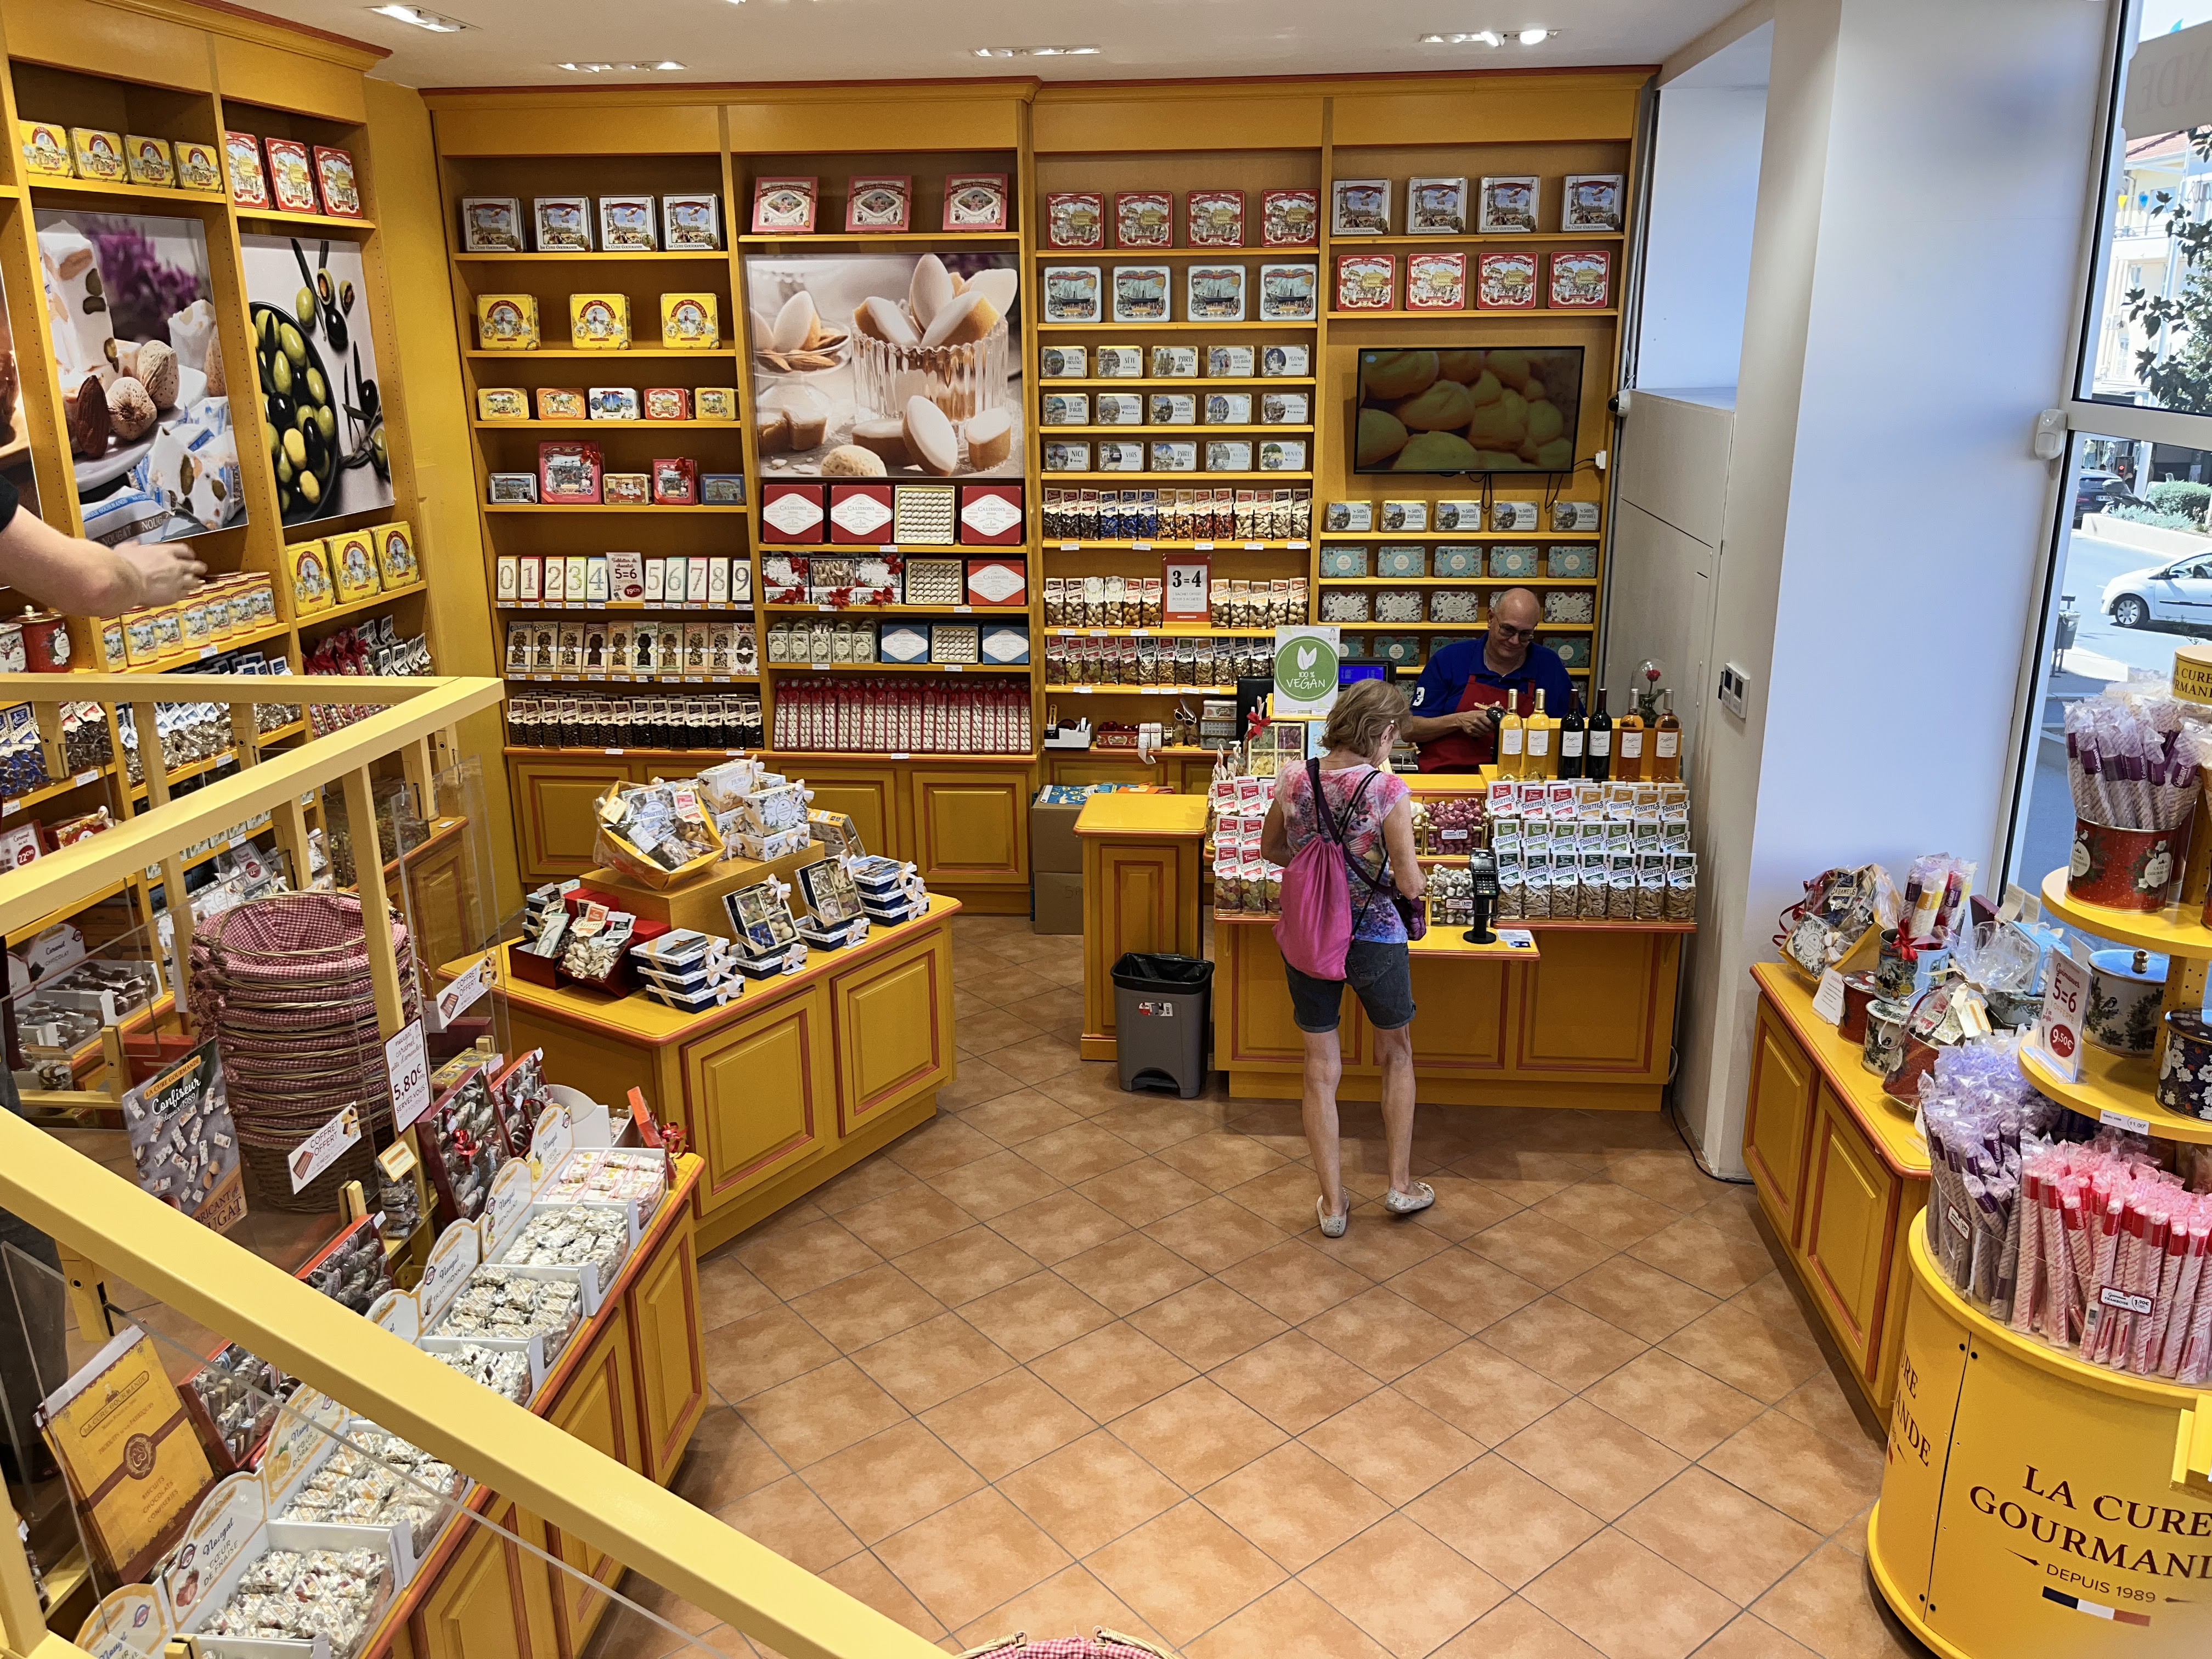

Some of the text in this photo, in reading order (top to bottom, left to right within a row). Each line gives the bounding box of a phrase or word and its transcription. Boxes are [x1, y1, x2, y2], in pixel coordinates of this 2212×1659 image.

[142, 516, 163, 531] NOUG
[101, 526, 132, 546] NOUGAT
[500, 565, 514, 590] 0
[523, 566, 534, 591] 1
[548, 567, 561, 591] 2
[568, 566, 582, 591] 3
[589, 567, 604, 591] 4
[615, 568, 637, 579] 5=6
[648, 567, 660, 590] 5
[668, 566, 681, 591] 6
[690, 567, 704, 591] 7
[712, 567, 724, 591] 8
[735, 567, 749, 592] 9
[1172, 570, 1201, 588] 3=4
[1286, 678, 1325, 690] VEGAN
[1413, 687, 1425, 706] 3
[12, 719, 33, 742] CARAMELS
[1521, 799, 1546, 811] FOSSETTES
[1550, 797, 1576, 811] FOSSETTES
[1578, 800, 1603, 812] FOSSETTES
[1609, 800, 1634, 811] FOSSETTES
[1634, 802, 1660, 814] FOSSETTES
[1662, 802, 1688, 813] FOSSETTES
[1494, 832, 1520, 845] FOSSETTES
[1524, 833, 1550, 846] FOSSETTES
[1551, 834, 1576, 847] FOSSETTES
[1579, 834, 1604, 847] FOSSETTES
[1605, 834, 1630, 847] FOSSETTES
[1634, 834, 1660, 847] FOSSETTES
[1663, 833, 1688, 847] FOSSETTES
[1498, 863, 1521, 877] FOSSETTES
[1524, 865, 1550, 878] FOSSETTES
[1551, 865, 1578, 878] FOSSETTES
[1581, 864, 1607, 877] FOSSETTES
[1609, 867, 1635, 879] FOSSETTES
[1640, 865, 1666, 879] FOSSETTES
[1670, 866, 1695, 879] FOSSETTES
[45, 950, 69, 966] CHOCOLAT
[457, 968, 477, 989] COFFRET
[460, 978, 476, 996] OFFERT
[2053, 977, 2076, 1013] 5=6
[2054, 1003, 2074, 1024] OFFERTE
[153, 1080, 168, 1092] CURE
[168, 1057, 201, 1083] GOURMANDE
[151, 1077, 201, 1115] Confiseur
[162, 1092, 196, 1122] depuis 1989
[310, 1120, 338, 1148] COFFRET
[314, 1131, 338, 1156] OFFERT
[195, 1189, 230, 1224] BRICANT
[207, 1197, 242, 1232] UGAT
[498, 1199, 518, 1228] MENDIANT
[433, 1261, 467, 1303] TRADITIONNEL
[2104, 1296, 2129, 1306] FRAMBOISE
[1901, 1343, 1918, 1400] URE
[92, 1374, 146, 1425] CURE GOURMANDE
[1896, 1390, 1931, 1468] ANDE
[292, 1433, 319, 1468] D'ORANGE
[142, 1475, 165, 1500] BISCUITS
[143, 1481, 174, 1514] CHOCOLATS
[147, 1489, 179, 1523] CONFISERIES
[2022, 1464, 2212, 1538] LA CURE
[202, 1516, 235, 1556] Nougat
[204, 1539, 239, 1587] DE FRAISE
[2046, 1564, 2156, 1603] DEPUIS 1989
